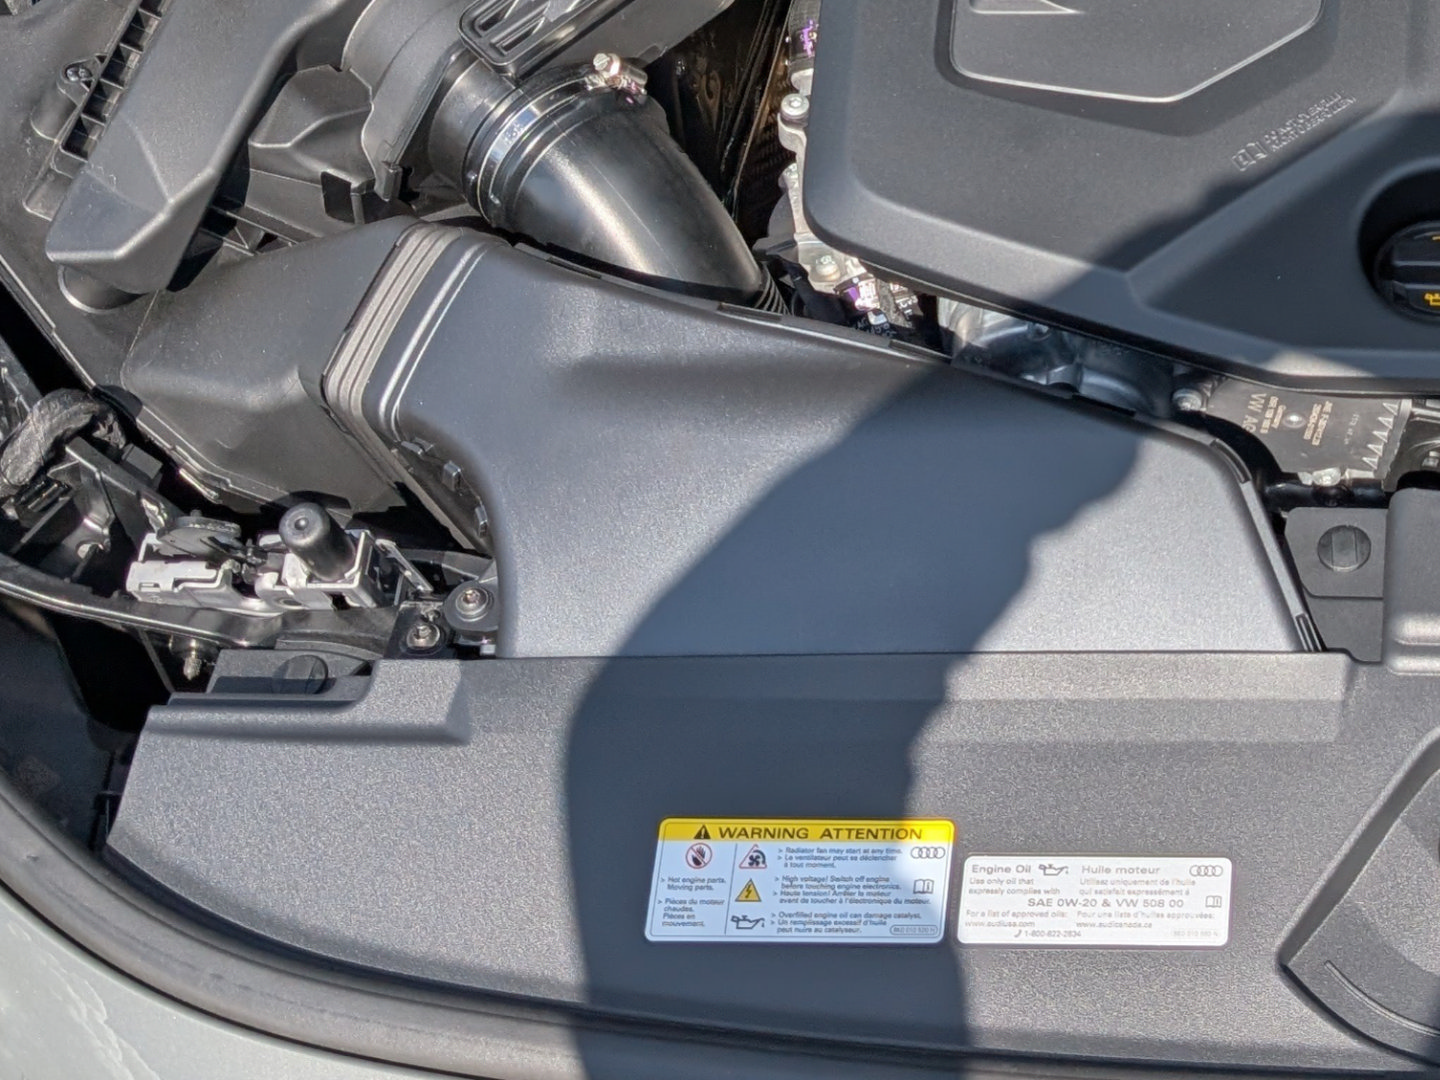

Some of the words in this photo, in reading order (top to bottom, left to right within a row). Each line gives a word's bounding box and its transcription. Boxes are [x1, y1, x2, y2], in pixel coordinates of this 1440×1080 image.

[1247, 393, 1267, 413] VW
[719, 827, 809, 839] WARNING
[820, 828, 922, 840] ATTENTION
[786, 846, 814, 854] Radiator
[817, 846, 827, 854] fan
[971, 864, 1012, 875] Engine
[1015, 864, 1031, 873] Oil
[1081, 865, 1112, 874] Huile
[1115, 865, 1160, 874] moteur
[682, 877, 706, 885] engine
[707, 877, 726, 885] parts.
[986, 878, 1004, 886] only
[1080, 878, 1108, 886] Utilisez
[1160, 878, 1169, 886] de
[968, 887, 1004, 896] expressly
[1006, 887, 1041, 896] complies
[1079, 888, 1092, 896] qui
[1094, 888, 1125, 896] satisfait
[1127, 888, 1183, 897] expressément
[1028, 898, 1053, 907] SAE
[1057, 898, 1098, 908] 0W-20
[1101, 899, 1111, 908] &
[1116, 899, 1139, 908] VW
[1143, 899, 1165, 908] 508
[1169, 900, 1184, 908] 00
[966, 909, 979, 917] For
[1012, 910, 1049, 918] approved
[1077, 910, 1095, 918] Pour
[965, 920, 1035, 928] www.audiusa.com
